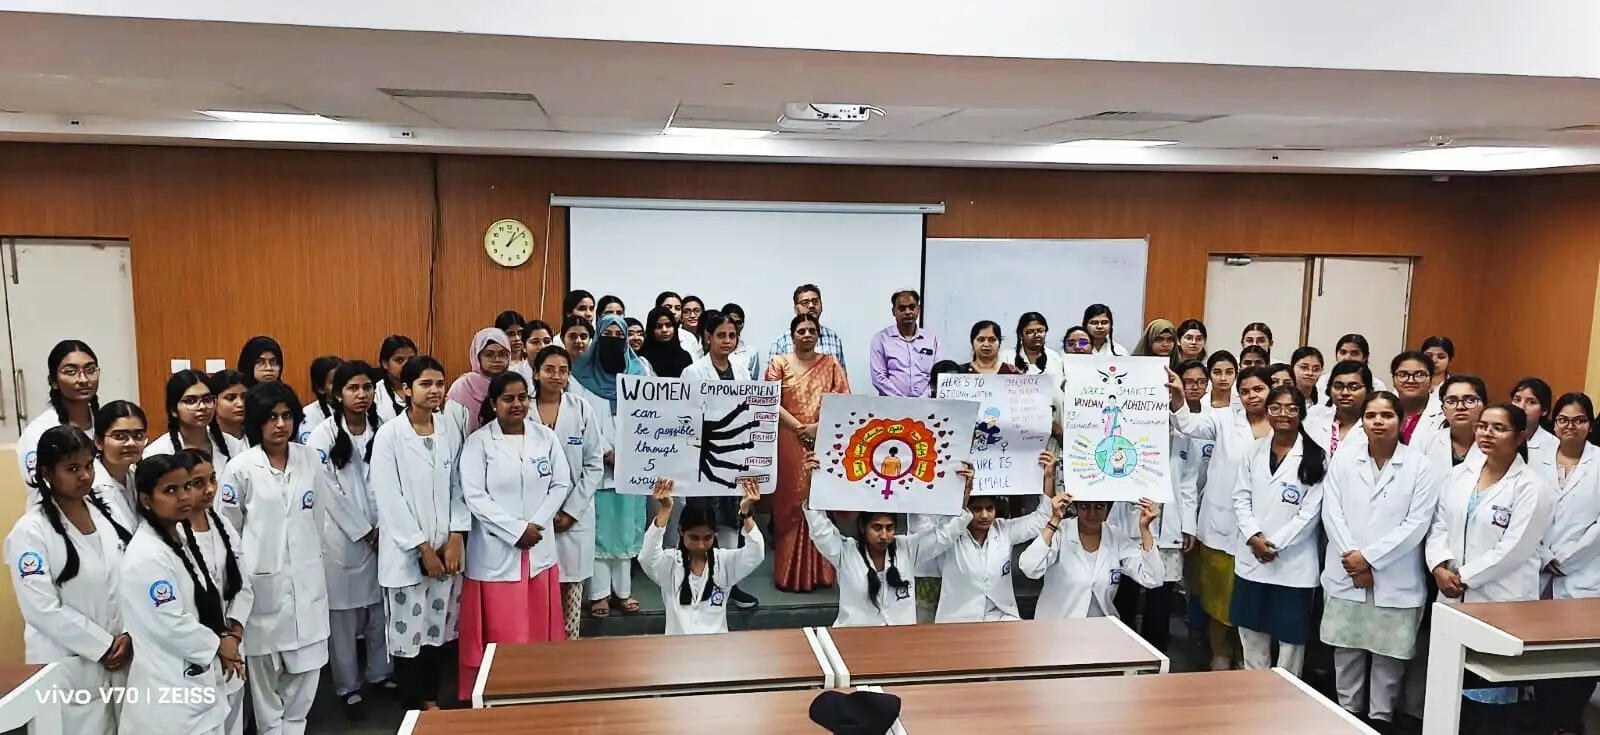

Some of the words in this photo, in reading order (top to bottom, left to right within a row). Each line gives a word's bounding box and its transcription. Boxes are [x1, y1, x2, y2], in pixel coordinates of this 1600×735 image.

[621, 377, 692, 401] WOMEN
[700, 382, 780, 396] EMPOWERMENT
[941, 376, 970, 388] HERE'S
[974, 377, 985, 388] TO
[1074, 397, 1104, 409] VANDAN
[1121, 399, 1168, 411] ADHINIYAM
[630, 408, 661, 419] can
[633, 423, 650, 435] be
[654, 424, 696, 441] possible
[634, 439, 679, 457] through
[643, 458, 656, 472] 5
[999, 456, 1013, 469] IS
[629, 476, 657, 490] way
[978, 476, 1012, 491] EMALE
